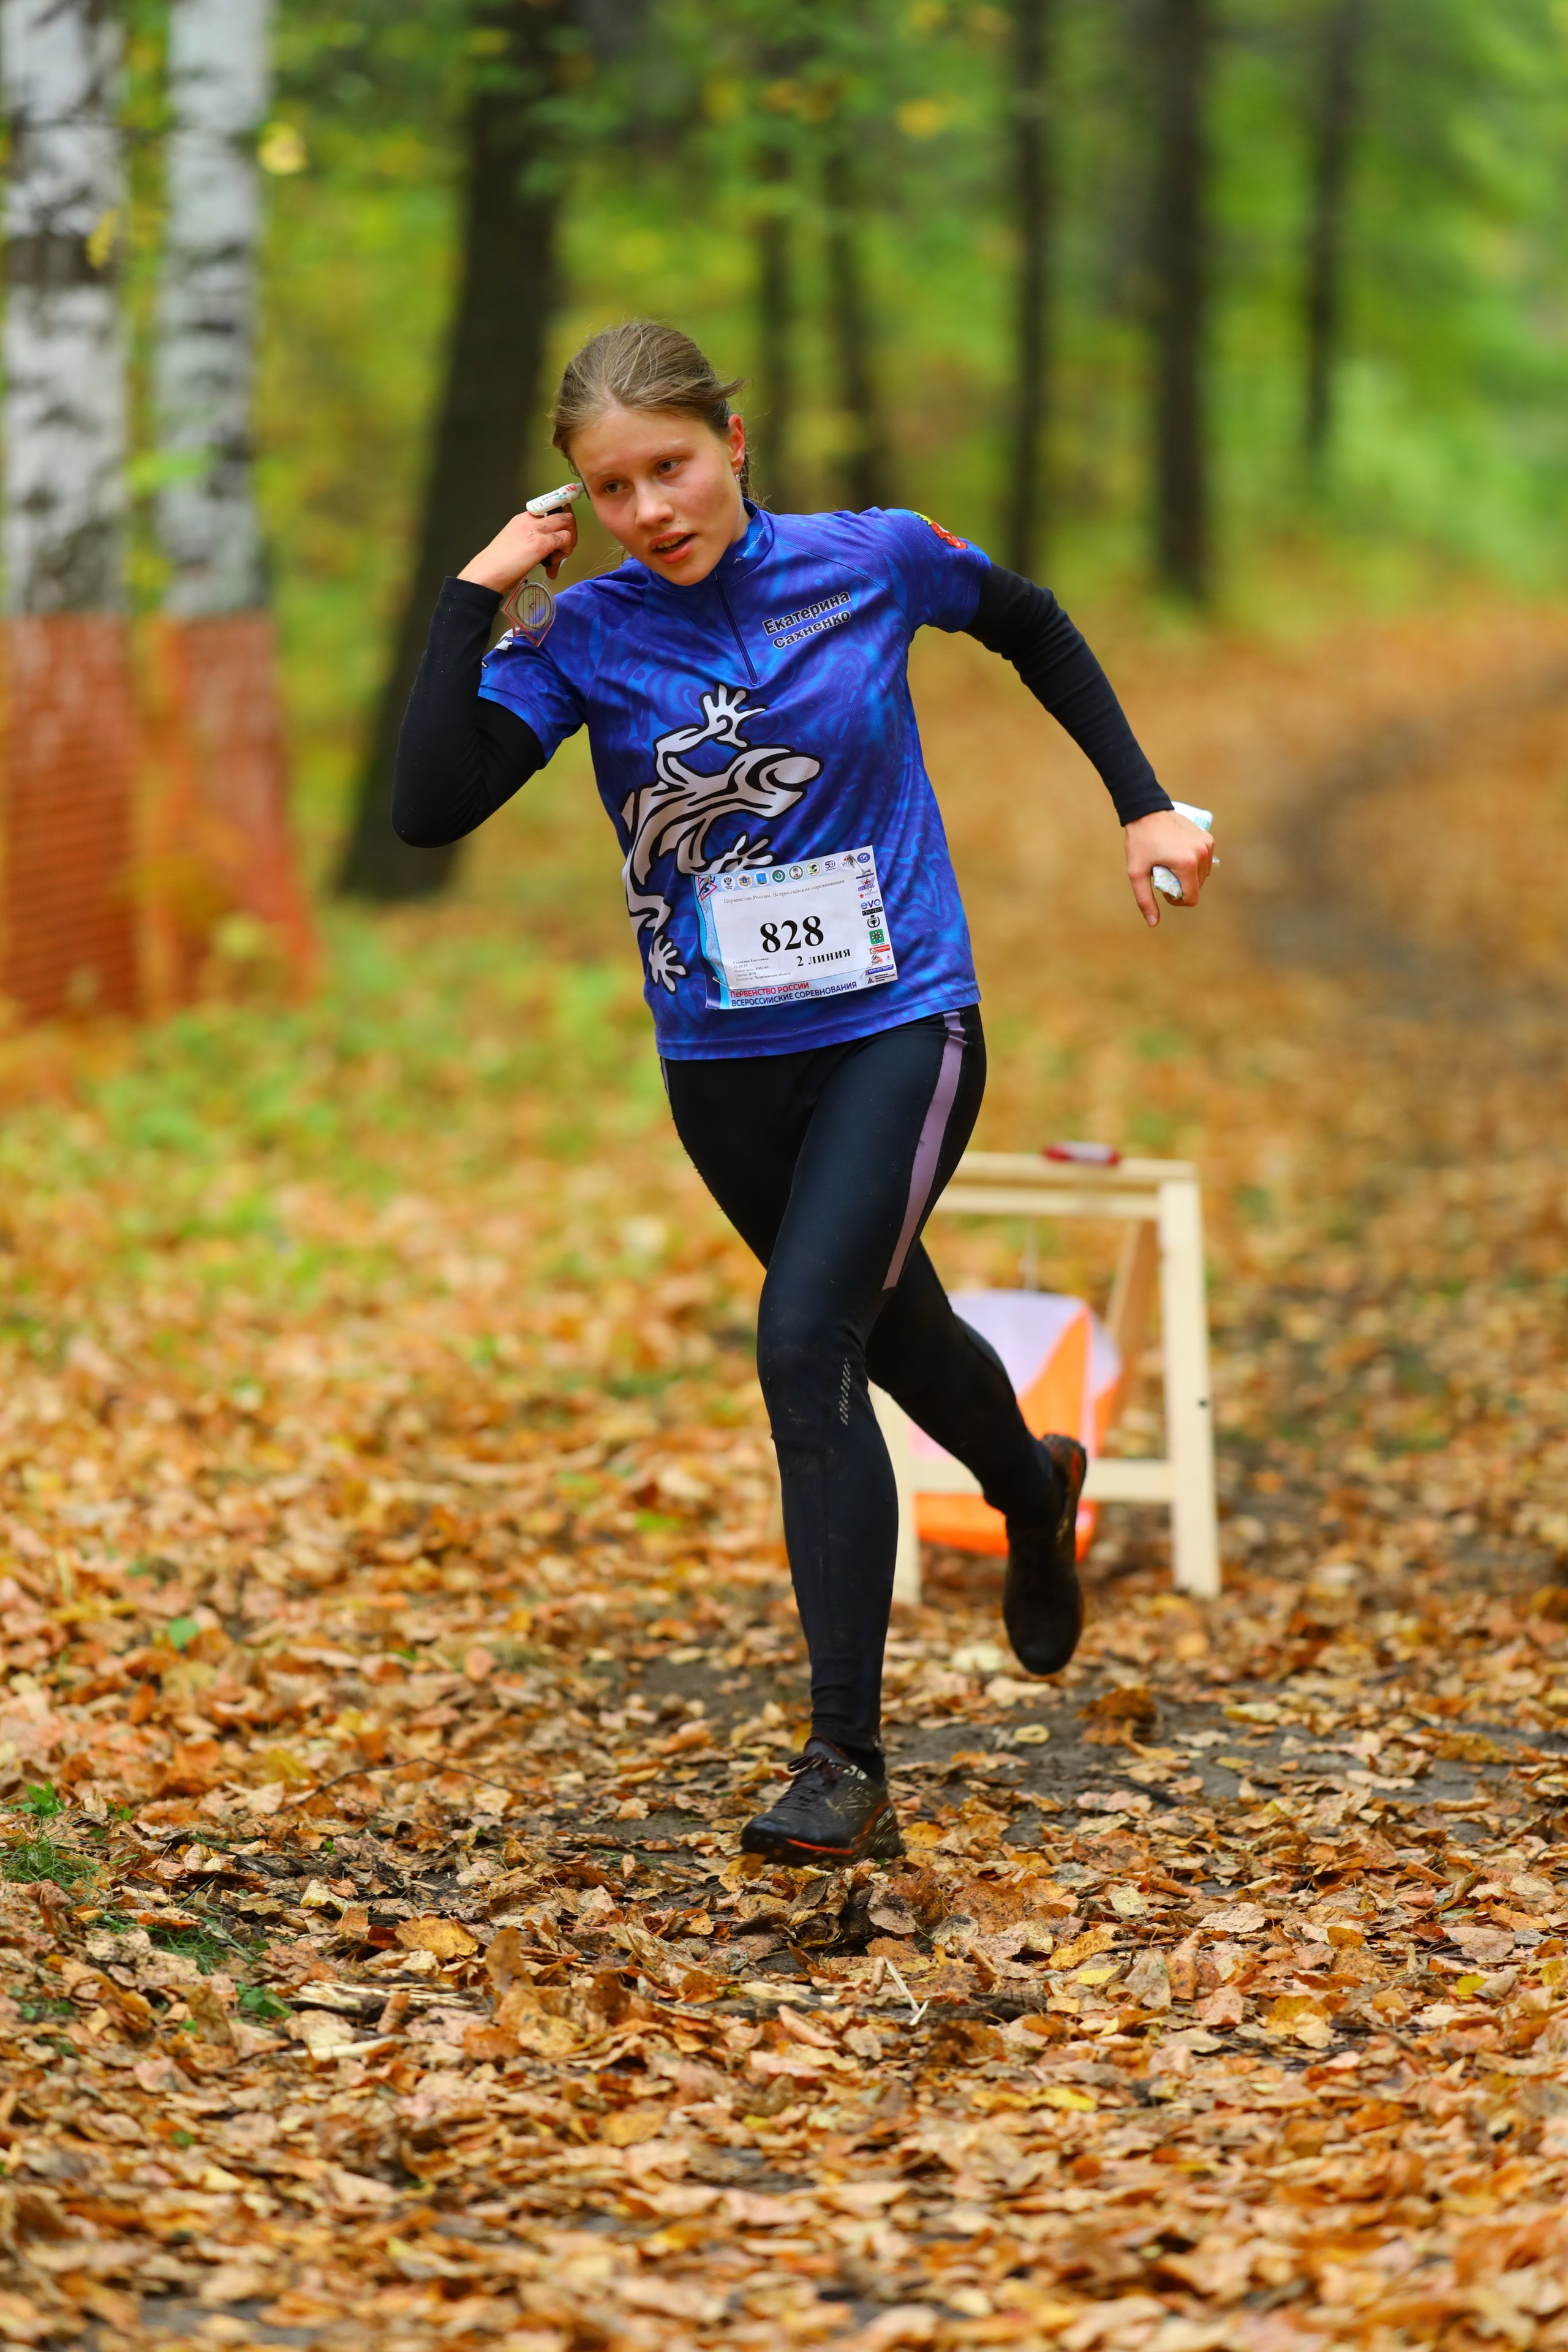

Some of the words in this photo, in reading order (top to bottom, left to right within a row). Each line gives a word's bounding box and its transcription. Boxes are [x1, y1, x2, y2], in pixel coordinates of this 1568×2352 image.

[763, 592, 851, 635] Екатерина
[773, 611, 851, 649] Сахненко
[773, 887, 811, 897] Всероссийские
[811, 880, 845, 890] соревнования
[861, 899, 881, 910] evo
[760, 916, 824, 953] 828
[796, 956, 804, 967] 2
[730, 987, 777, 998] ПЕРВЕНСТВО
[778, 982, 809, 993] РОССИИ
[794, 981, 858, 999] СОРЕВНОВАНИЯ
